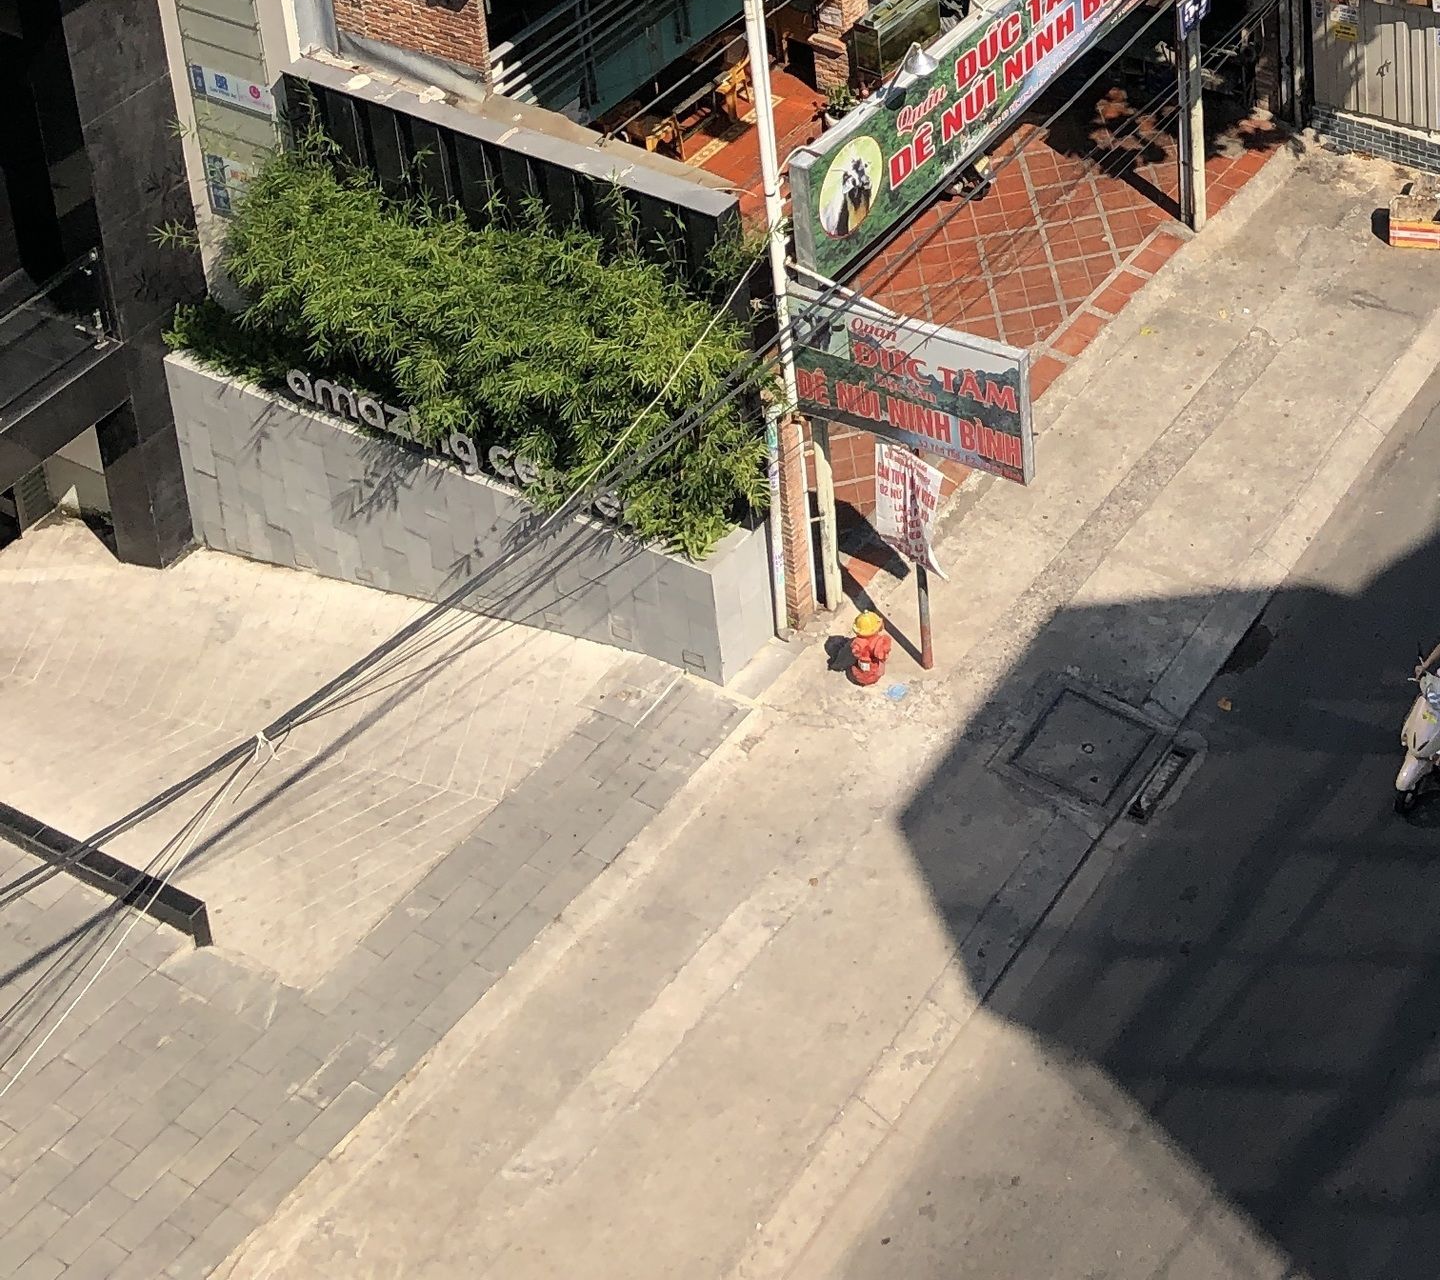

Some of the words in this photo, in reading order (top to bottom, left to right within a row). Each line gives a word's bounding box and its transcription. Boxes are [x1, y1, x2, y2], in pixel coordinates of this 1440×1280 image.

[955, 7, 1022, 91] ĐỨC
[889, 121, 935, 190] DÊ
[942, 70, 998, 145] NÚI
[1003, 3, 1076, 93] NINH
[851, 317, 898, 342] Quán
[286, 369, 482, 476] amazg
[796, 368, 831, 406] DÊ
[835, 379, 881, 421] NÚI
[886, 395, 952, 444] NINH
[958, 416, 1023, 468] BÌNH
[853, 342, 932, 386] ĐỨC
[937, 366, 1019, 414] TÂM
